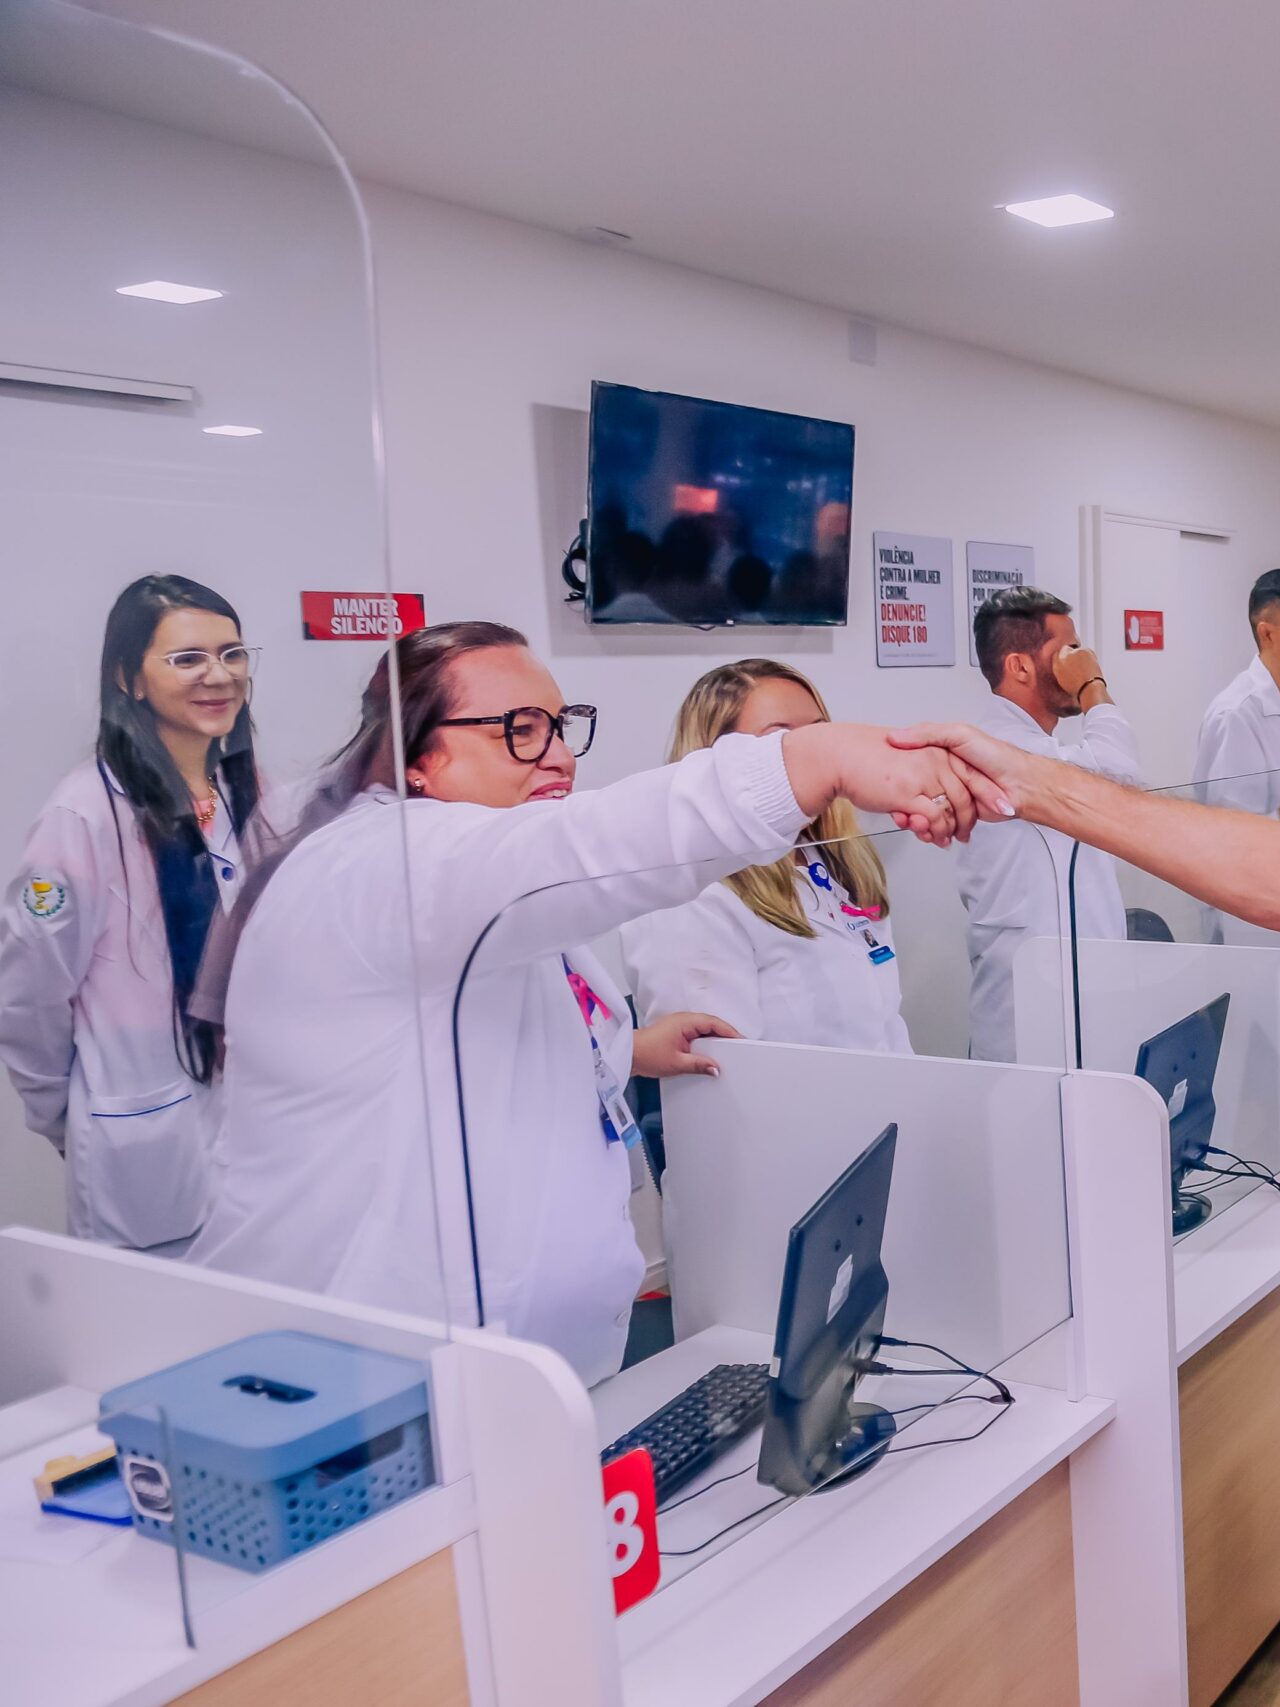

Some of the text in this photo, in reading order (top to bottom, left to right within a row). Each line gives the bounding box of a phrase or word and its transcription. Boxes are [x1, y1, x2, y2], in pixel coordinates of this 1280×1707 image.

[879, 545, 914, 565] VIOLÊNCIA
[880, 567, 941, 584] CONTRA A MULHER
[972, 568, 1023, 586] DISCRIMINAÇÃO
[333, 598, 399, 617] MANTER
[881, 603, 926, 622] DENUNCIE!
[331, 616, 403, 635] SILENCO
[882, 625, 928, 647] DISQUE 180
[605, 1490, 645, 1578] 8
